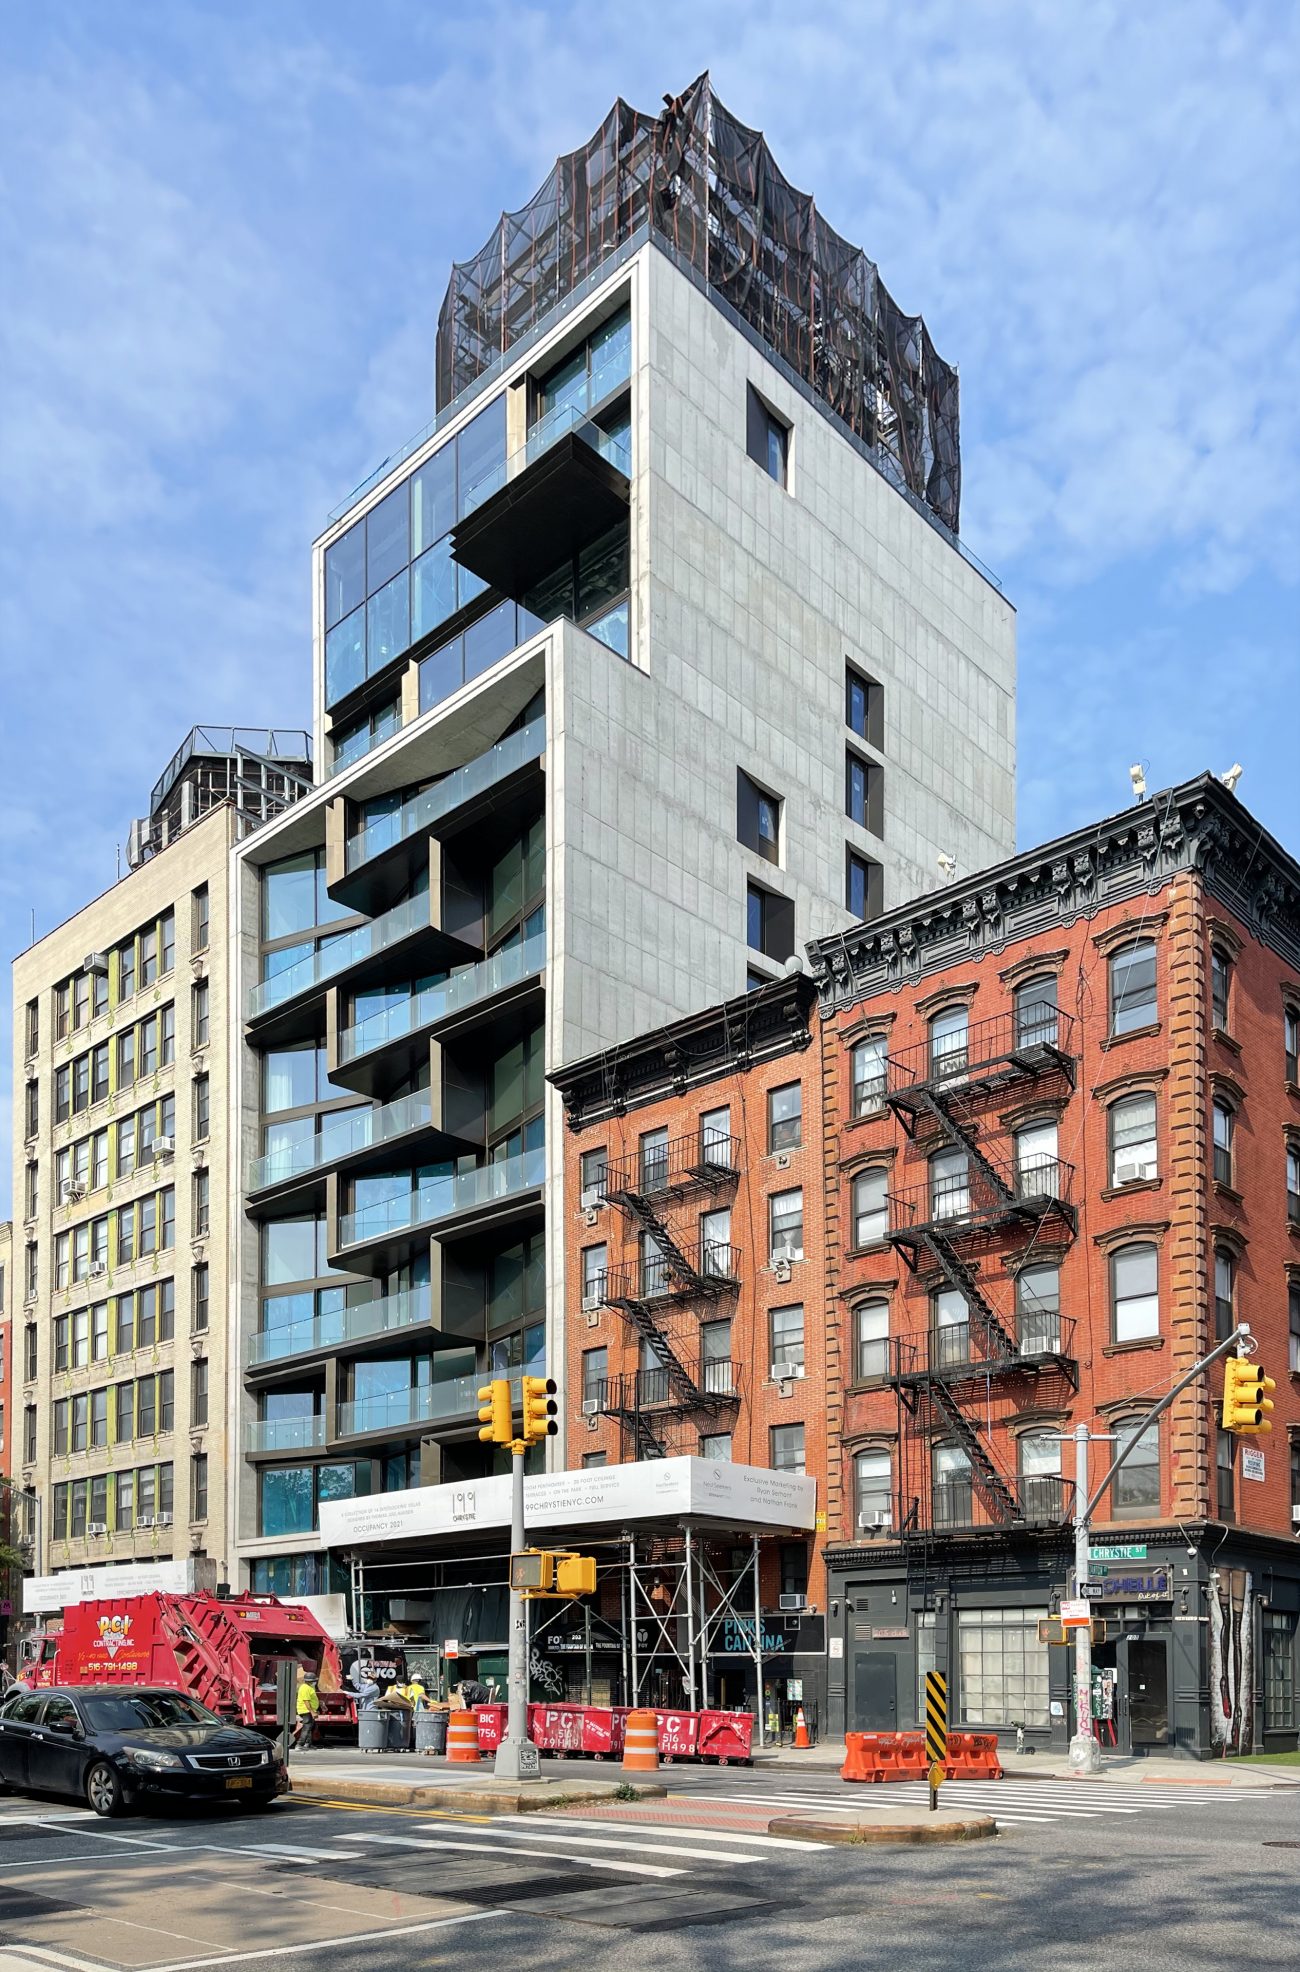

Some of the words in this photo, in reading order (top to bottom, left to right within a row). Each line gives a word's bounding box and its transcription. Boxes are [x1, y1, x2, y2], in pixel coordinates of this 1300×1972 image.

[526, 1496, 604, 1511] 99CHRYSTIENYC.COM
[353, 1522, 388, 1533] OCCUPANCY
[390, 1520, 403, 1528] 2021
[1094, 1547, 1132, 1558] CHRYSTIE
[548, 1636, 562, 1644] FO
[725, 1635, 785, 1651] CANINA
[88, 1662, 138, 1671] 516-791-1498
[480, 1714, 494, 1723] BIC
[662, 1734, 678, 1743] 516
